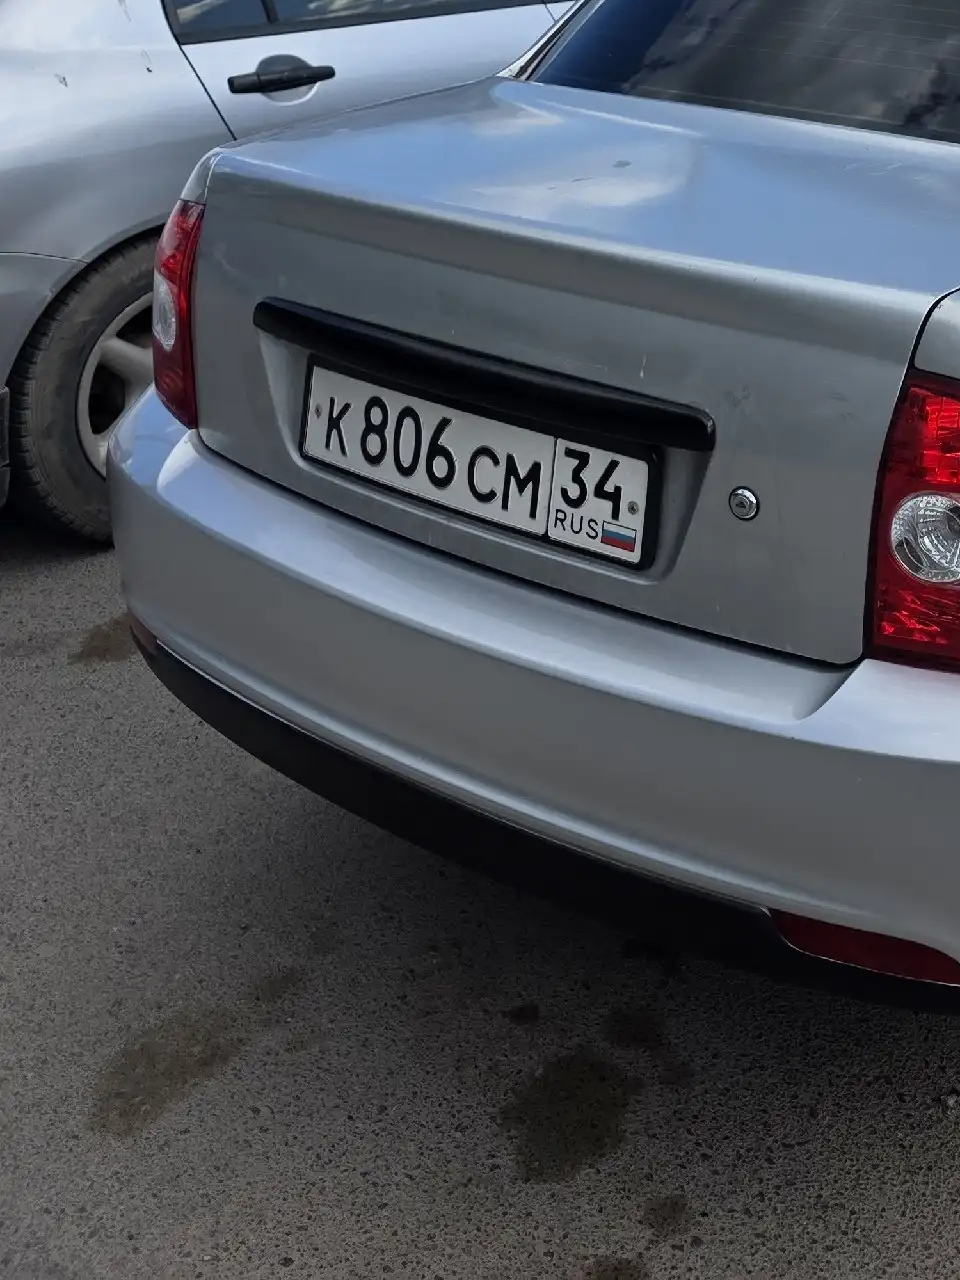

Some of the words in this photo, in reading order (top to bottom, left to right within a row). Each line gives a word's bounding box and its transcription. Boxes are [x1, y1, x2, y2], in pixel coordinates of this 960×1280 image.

[325, 396, 542, 520] К806СМ
[560, 447, 622, 521] 34
[554, 508, 600, 541] RUS
